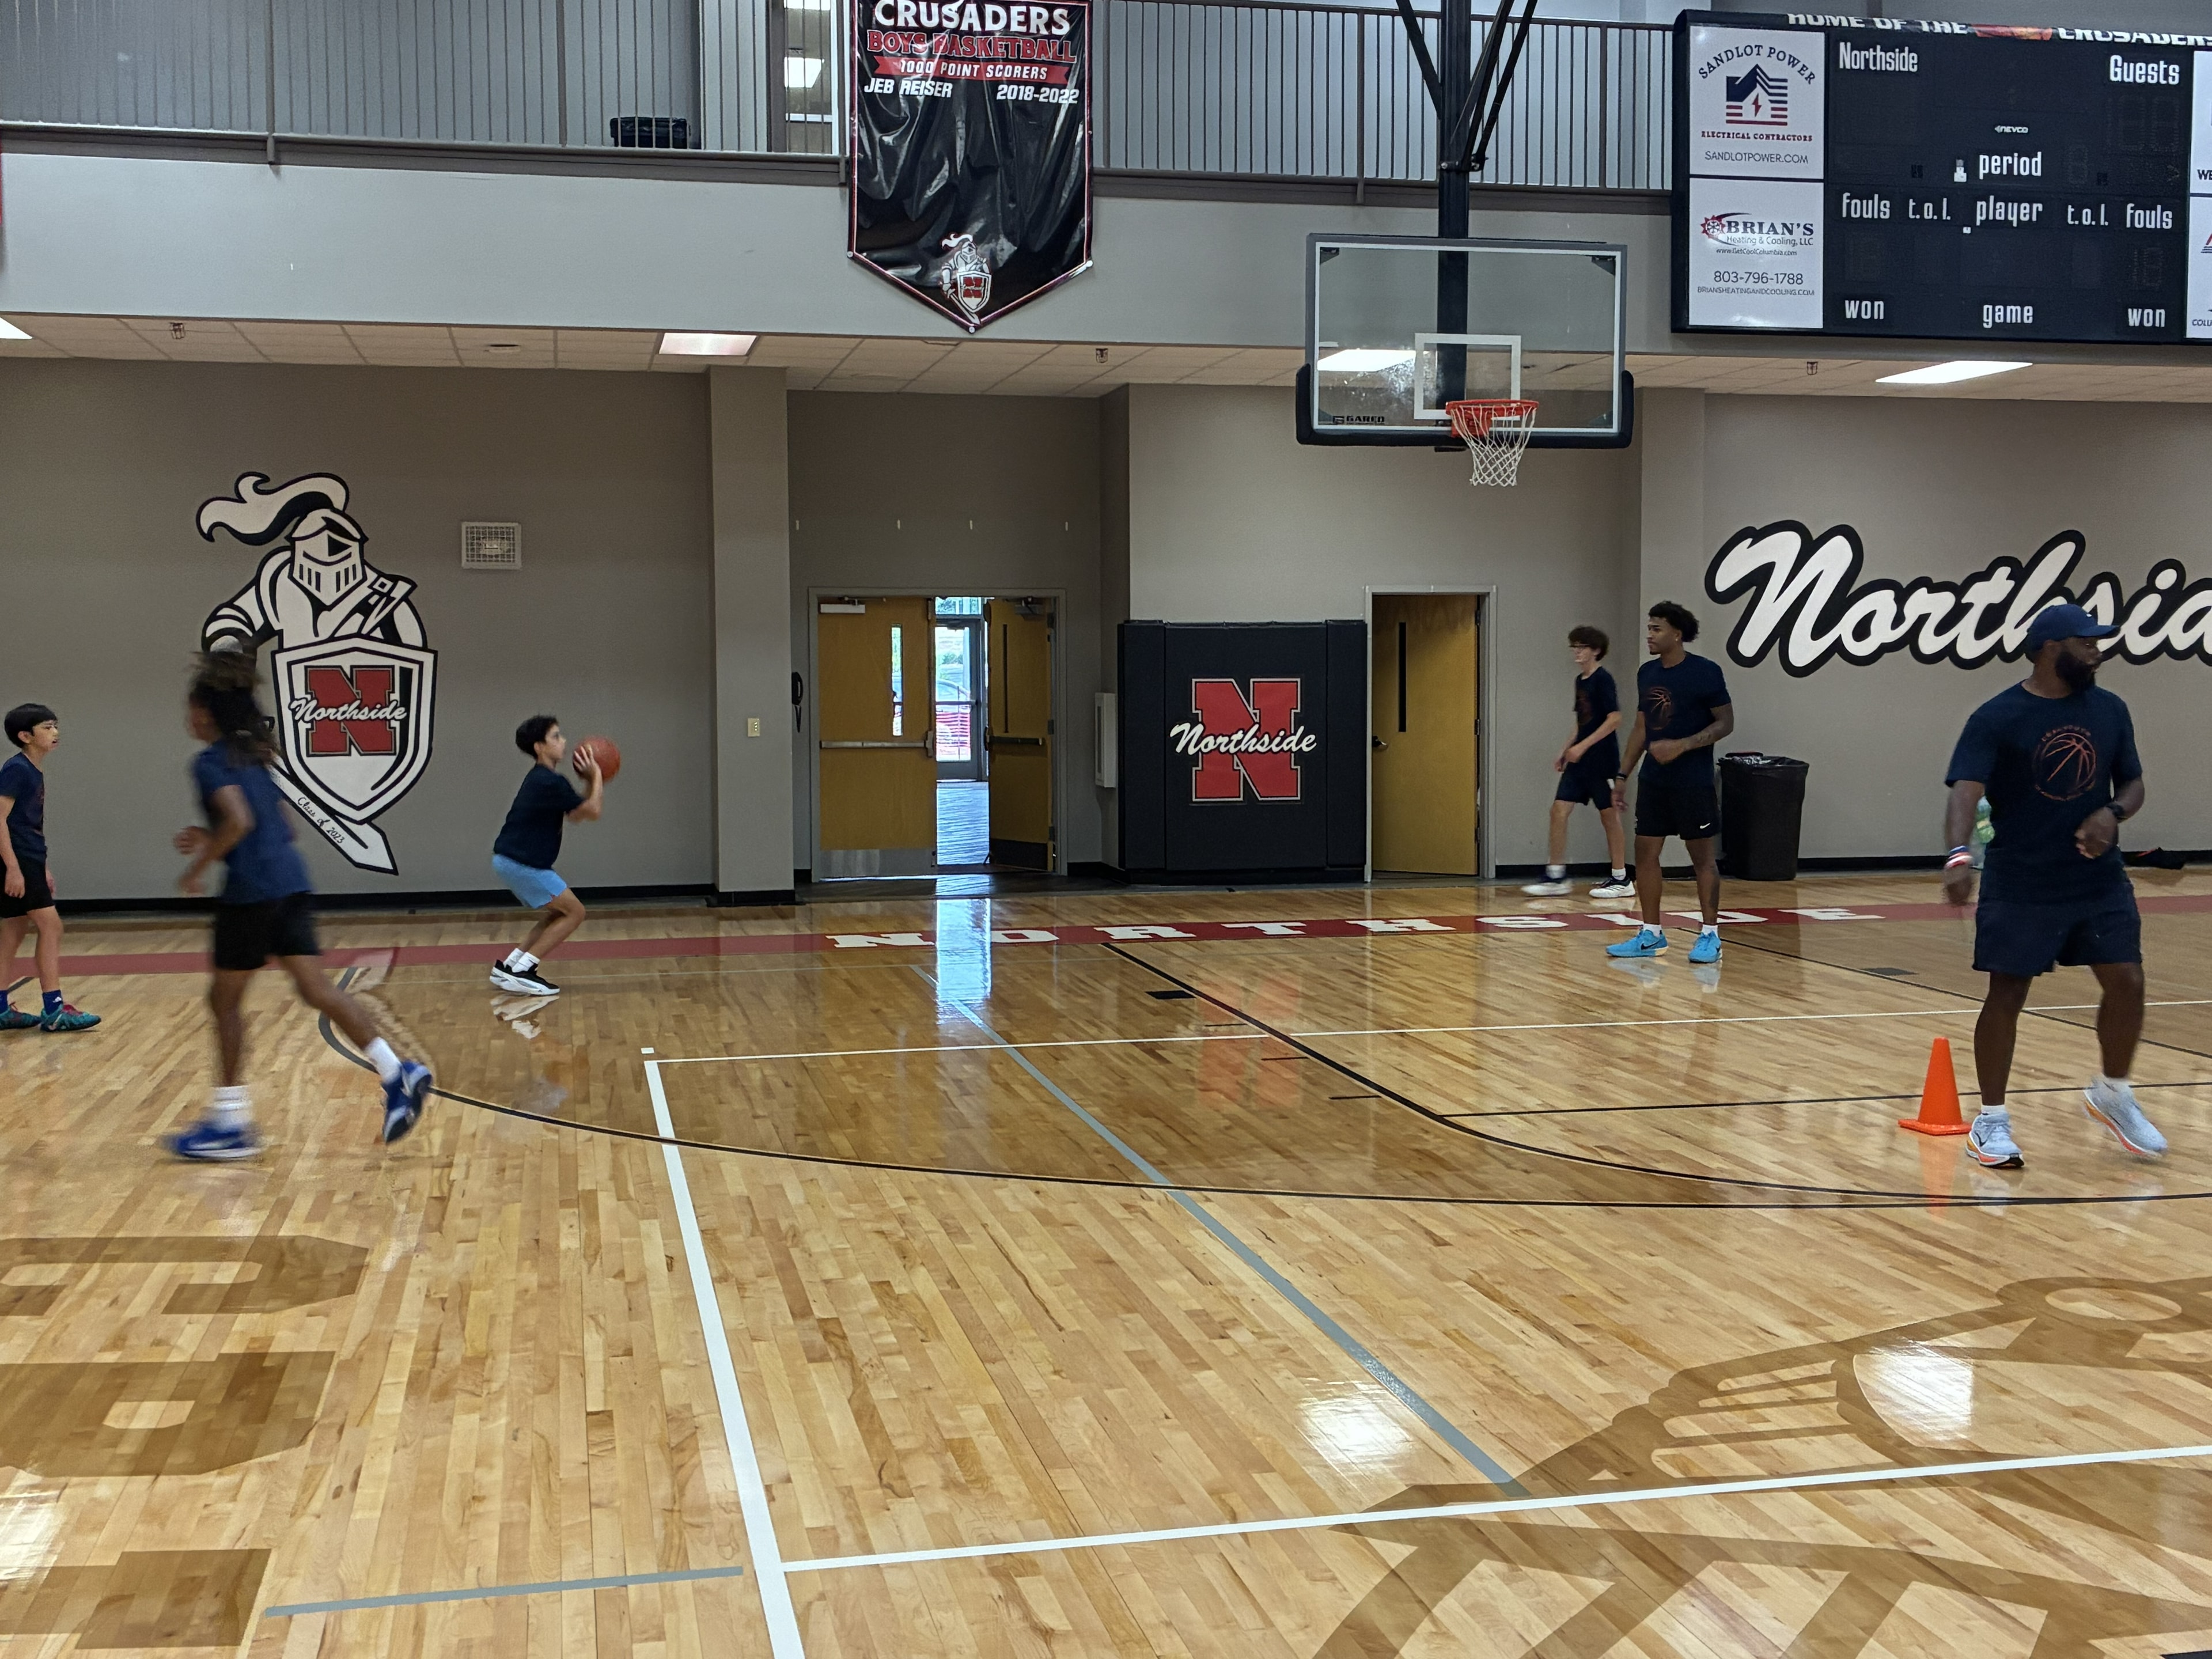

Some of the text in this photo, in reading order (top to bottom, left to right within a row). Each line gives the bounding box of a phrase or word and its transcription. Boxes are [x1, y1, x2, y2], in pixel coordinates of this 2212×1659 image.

[875, 0, 1070, 36] CRUSADERS
[866, 29, 1077, 63] BOYS BASKETBALL
[1839, 41, 1918, 72] Northside
[900, 59, 1048, 79] 1000 POINT SCORERS
[1699, 44, 1816, 85] SANDLOT POWER
[2109, 55, 2180, 85] Guests
[864, 78, 953, 98] JEB REISER
[996, 84, 1080, 104] 2018-2022
[1701, 131, 1813, 142] ELECTRICAL CONTRACTORS
[1705, 151, 1809, 164] SANDLOTPOWER.COM
[1979, 151, 2041, 180] period
[1842, 192, 1891, 219] fouls
[1976, 195, 2043, 227] player
[2126, 203, 2172, 229] fouls
[1726, 220, 1814, 236] BRIAN'S
[1726, 236, 1813, 247] Heating & Cooling, LLC
[1714, 270, 1804, 285] 803-796-1788
[1844, 299, 1884, 320] won
[1983, 302, 2033, 328] game
[2127, 306, 2166, 328] won
[289, 698, 407, 721] Northside
[1169, 722, 1317, 756] Northside
[298, 797, 316, 817] Class
[326, 827, 345, 843] 2023
